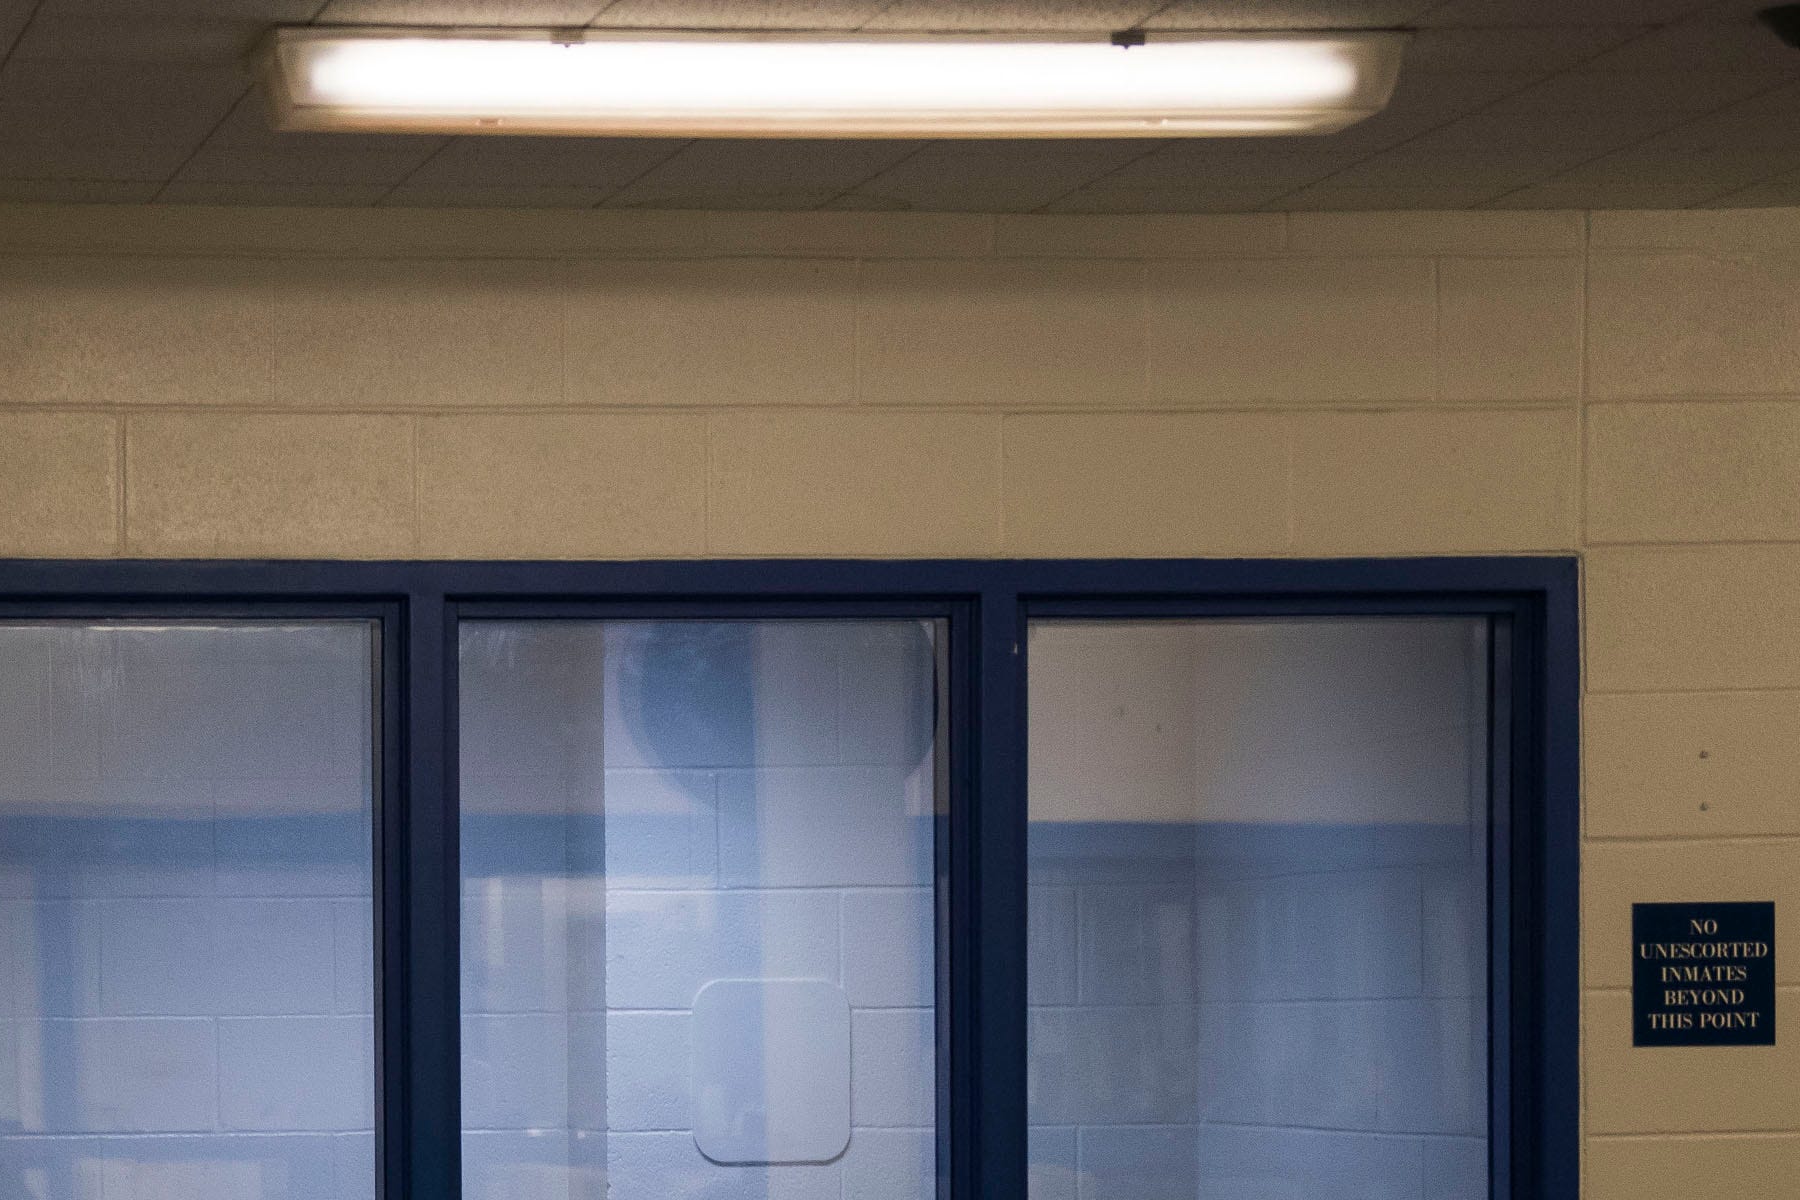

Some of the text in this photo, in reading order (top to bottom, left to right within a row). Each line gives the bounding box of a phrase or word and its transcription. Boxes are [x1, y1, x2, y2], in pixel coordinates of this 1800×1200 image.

[1690, 919, 1718, 935] NO
[1640, 942, 1768, 959] UNESCORTED
[1661, 966, 1747, 982] INMATES
[1664, 989, 1745, 1006] BEYOND
[1648, 1012, 1760, 1029] THIS POINT
